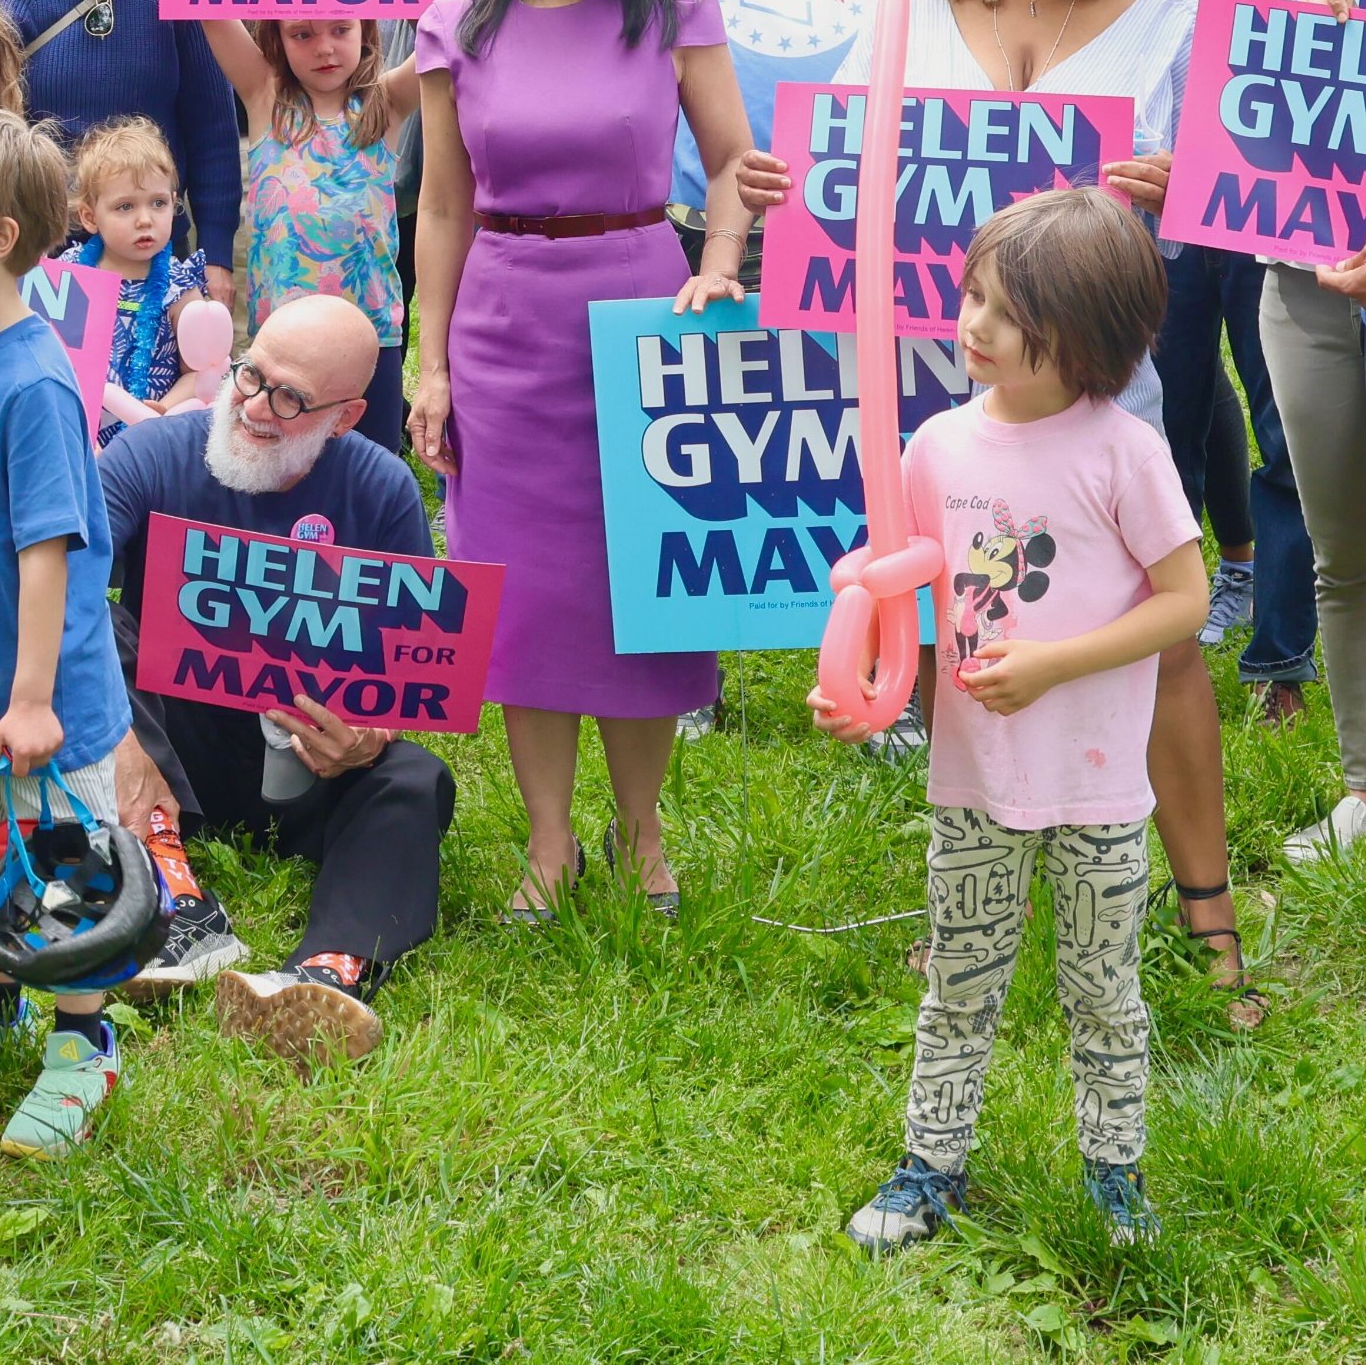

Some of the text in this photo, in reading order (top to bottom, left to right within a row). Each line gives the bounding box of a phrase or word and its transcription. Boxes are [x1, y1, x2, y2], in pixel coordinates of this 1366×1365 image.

[799, 256, 961, 321] MAY
[642, 408, 864, 487] GYM
[298, 523, 327, 532] HELEN
[946, 495, 990, 510] Cape Cod
[297, 531, 319, 540] GYM
[183, 528, 446, 612] HELEN
[178, 580, 456, 665] GYM FOR
[780, 601, 788, 609] by
[791, 600, 818, 608] Friends
[173, 648, 450, 720] MAYOR
